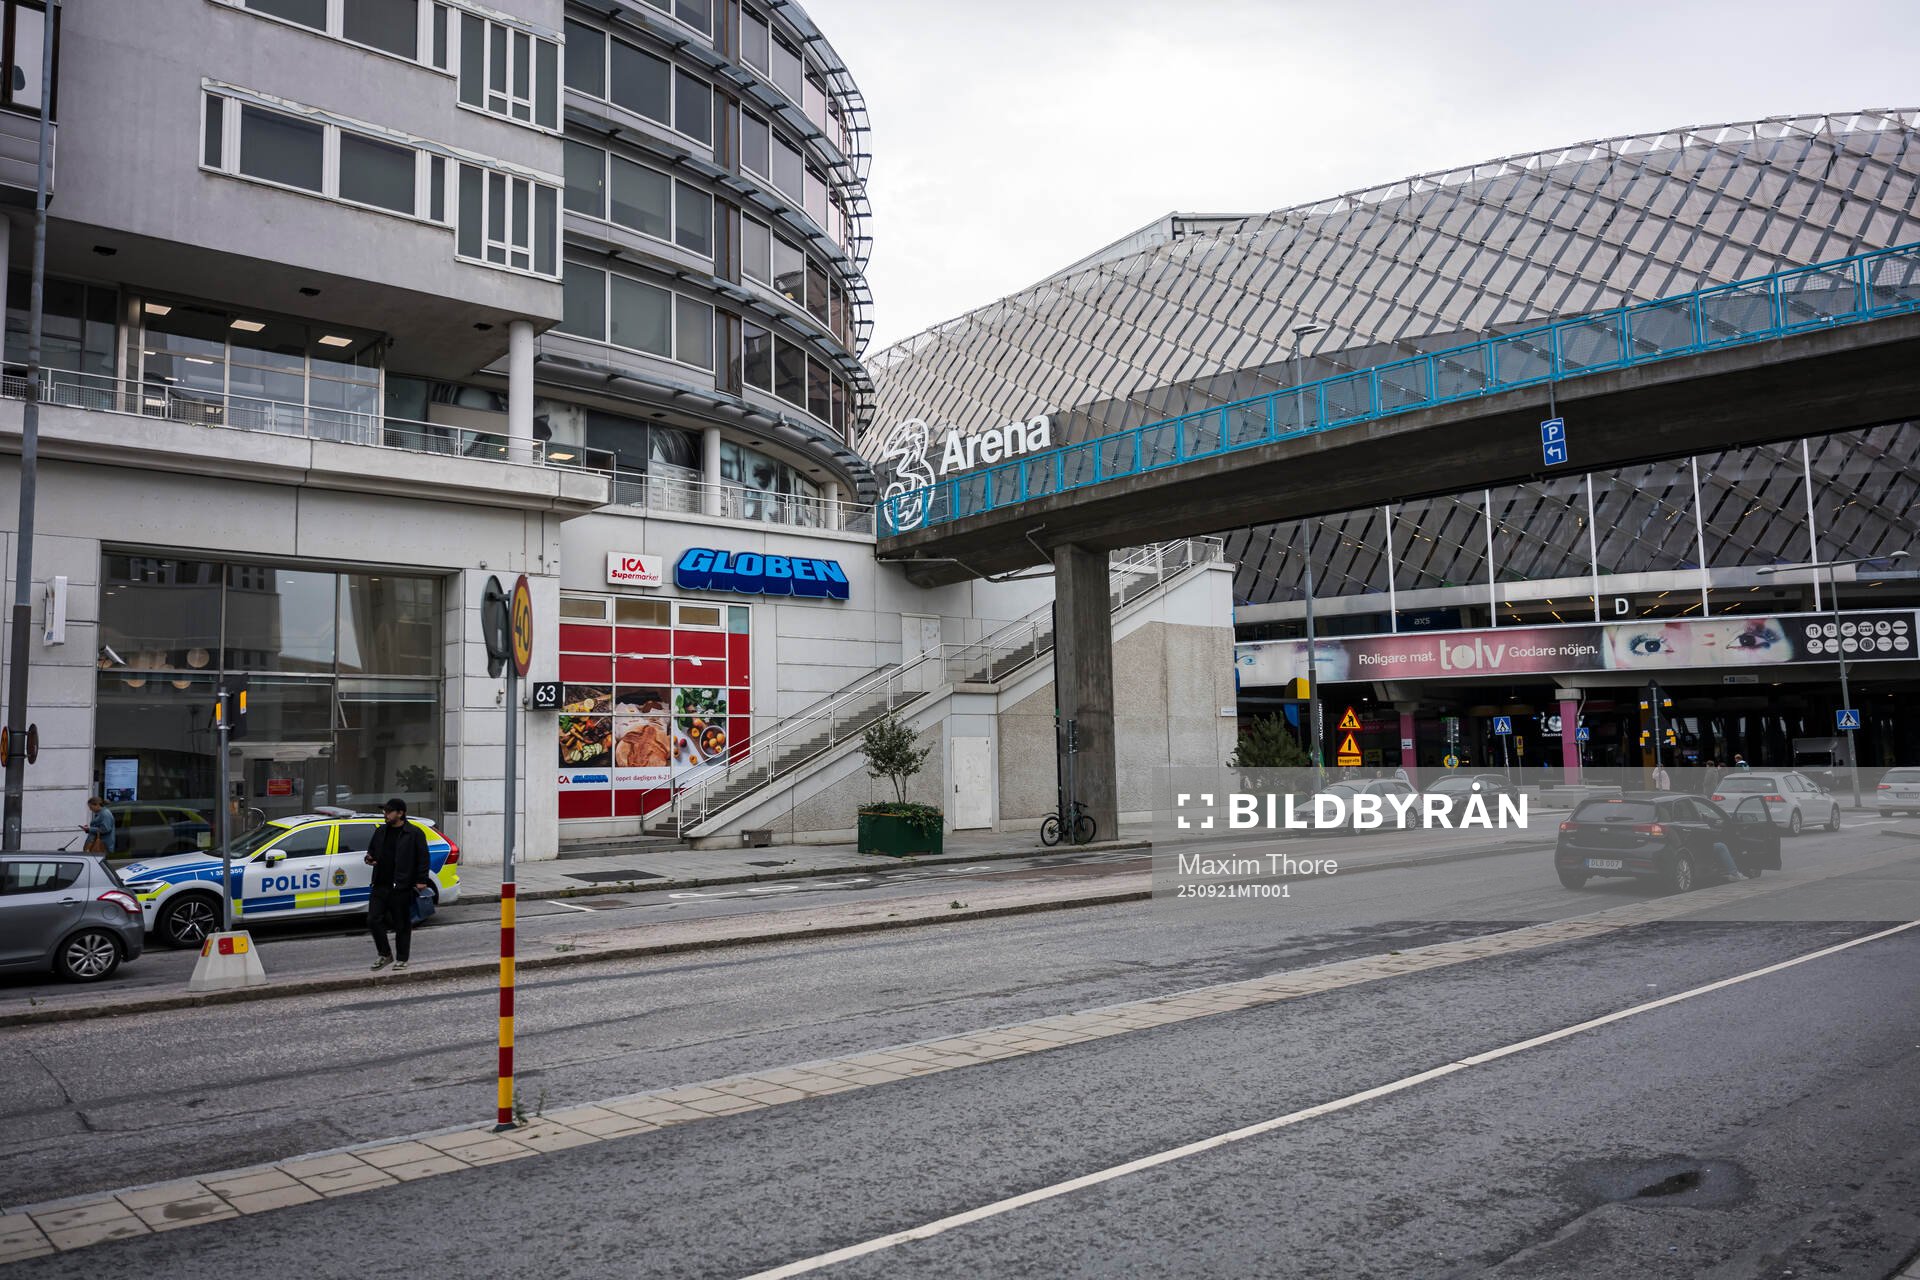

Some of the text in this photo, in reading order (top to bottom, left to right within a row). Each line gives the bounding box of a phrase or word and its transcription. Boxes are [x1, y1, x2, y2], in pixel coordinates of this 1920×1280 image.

[1548, 426, 1558, 440] P
[940, 414, 1051, 475] Arena
[621, 557, 645, 573] ICA
[677, 549, 848, 590] GLOBEN
[611, 569, 659, 581] Supermarket
[1615, 598, 1629, 615] D
[515, 598, 530, 652] 40
[1414, 617, 1431, 625] axs
[1359, 637, 1598, 670] Roligare mat. tolv Godare nöjen.
[536, 685, 556, 702] 63
[558, 775, 570, 785] CA
[261, 873, 321, 892] POLIS
